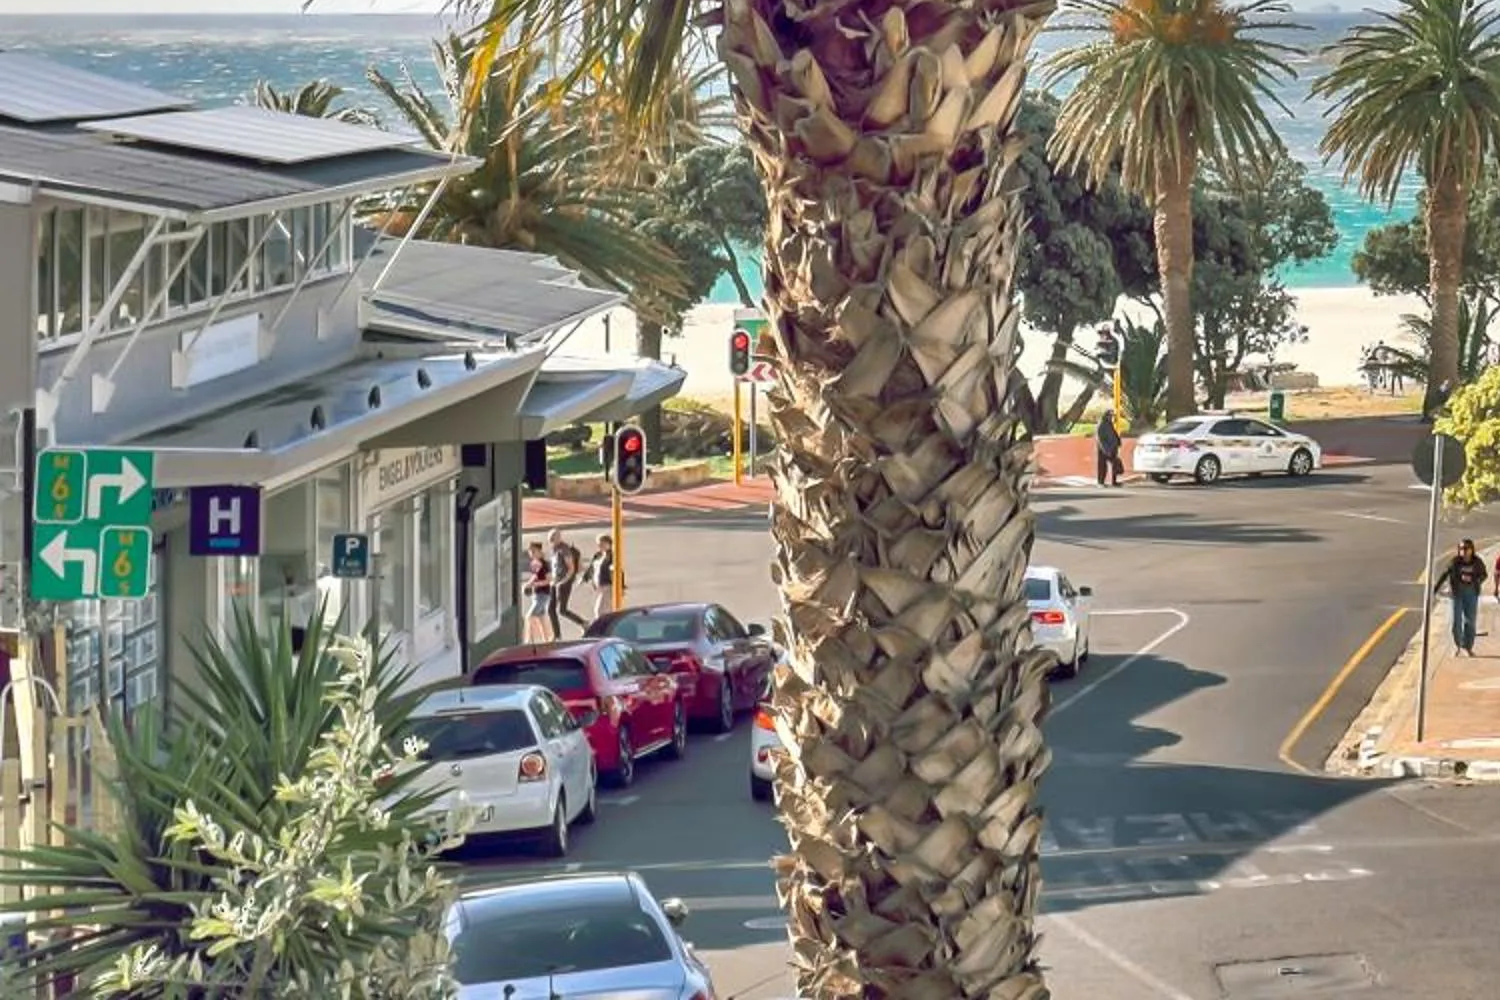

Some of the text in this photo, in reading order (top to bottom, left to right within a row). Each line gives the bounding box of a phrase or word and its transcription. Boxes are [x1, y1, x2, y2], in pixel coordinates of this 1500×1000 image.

[52, 473, 69, 501] 6
[209, 496, 241, 535] H
[345, 537, 361, 556] P
[114, 549, 132, 578] 6
